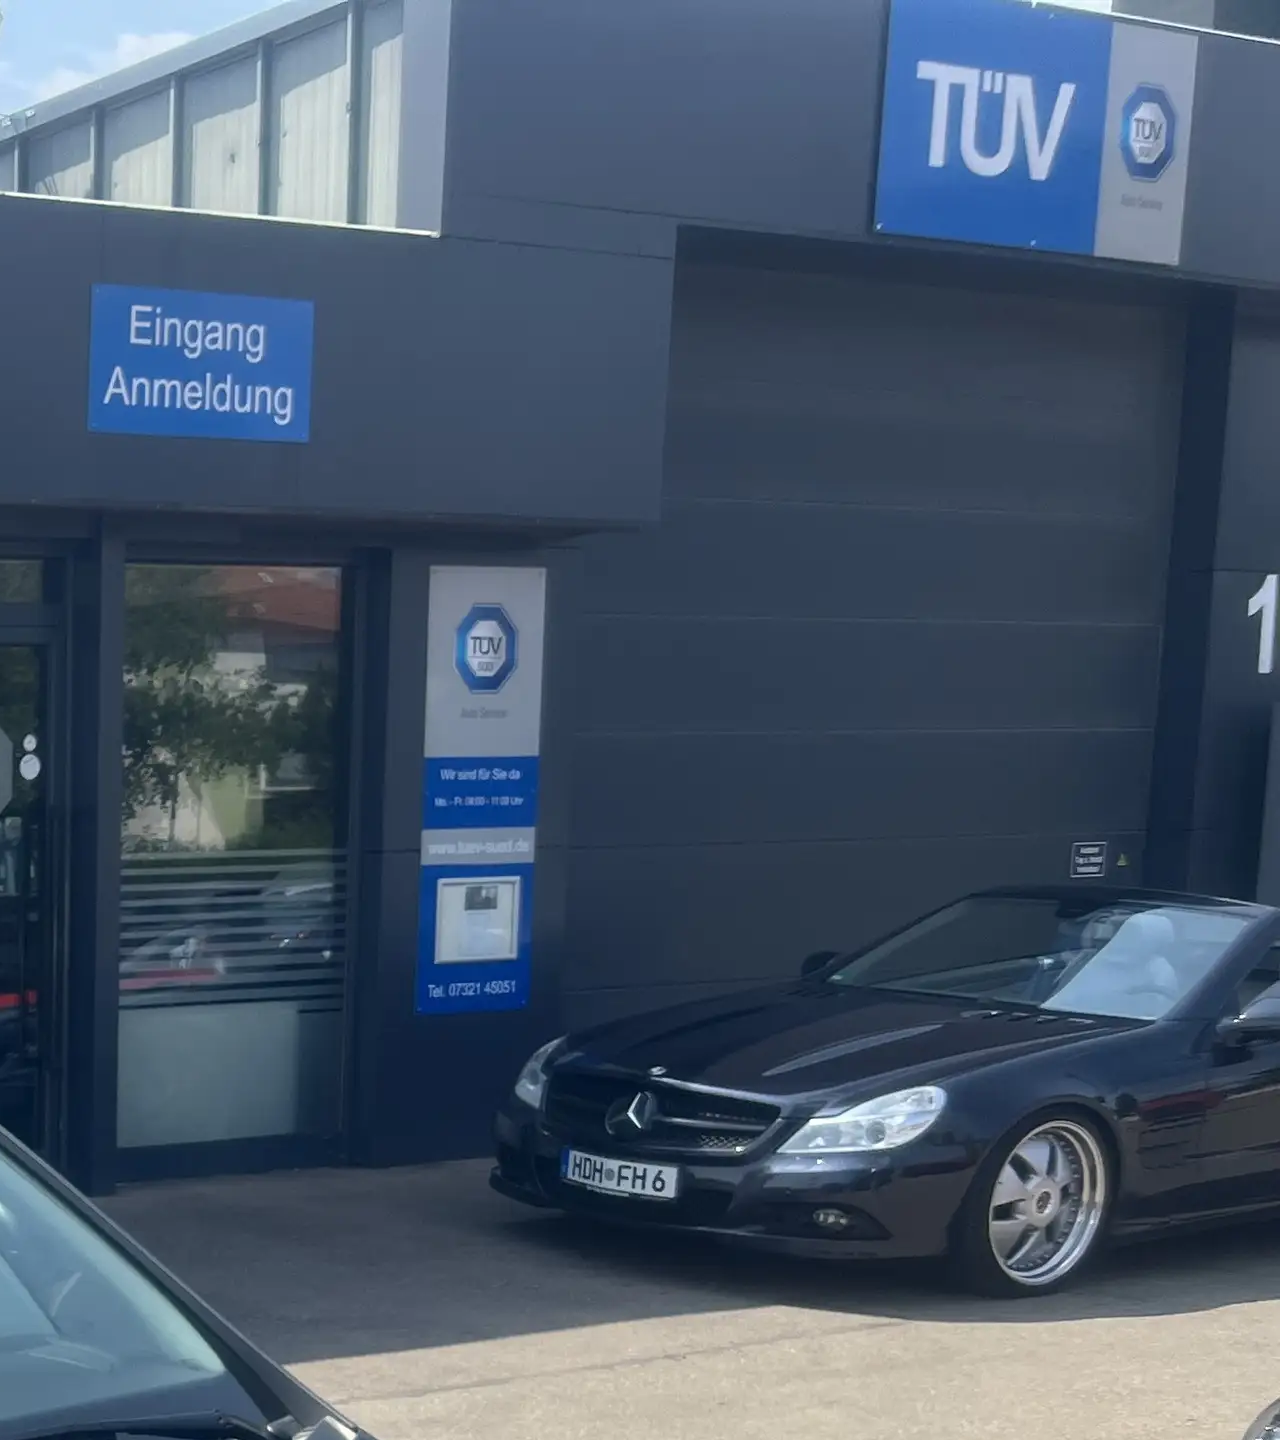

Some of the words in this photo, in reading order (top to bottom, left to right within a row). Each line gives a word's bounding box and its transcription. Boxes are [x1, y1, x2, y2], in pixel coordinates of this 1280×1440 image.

[917, 60, 1076, 181] TÜV
[129, 304, 265, 364] Eingang
[102, 365, 293, 426] Anmeldung
[448, 982, 480, 997] 07321
[571, 1156, 605, 1184] HDH
[616, 1165, 648, 1191] FH
[651, 1170, 666, 1193] 6
